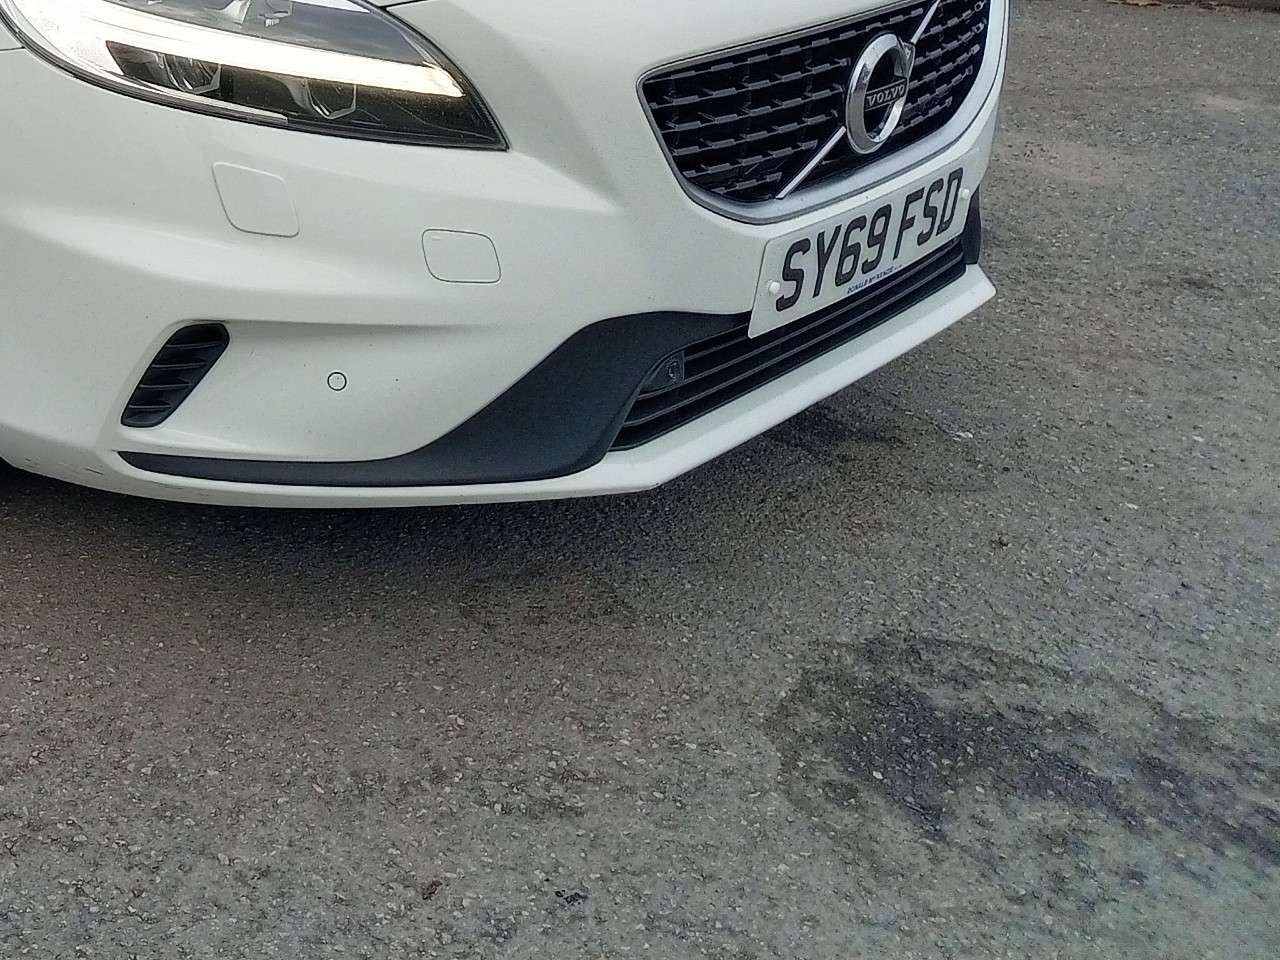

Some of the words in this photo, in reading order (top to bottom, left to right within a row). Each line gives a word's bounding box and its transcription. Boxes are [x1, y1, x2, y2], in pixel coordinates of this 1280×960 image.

[866, 84, 905, 107] VOLVO
[776, 204, 892, 312] SY69
[893, 167, 964, 260] FSD
